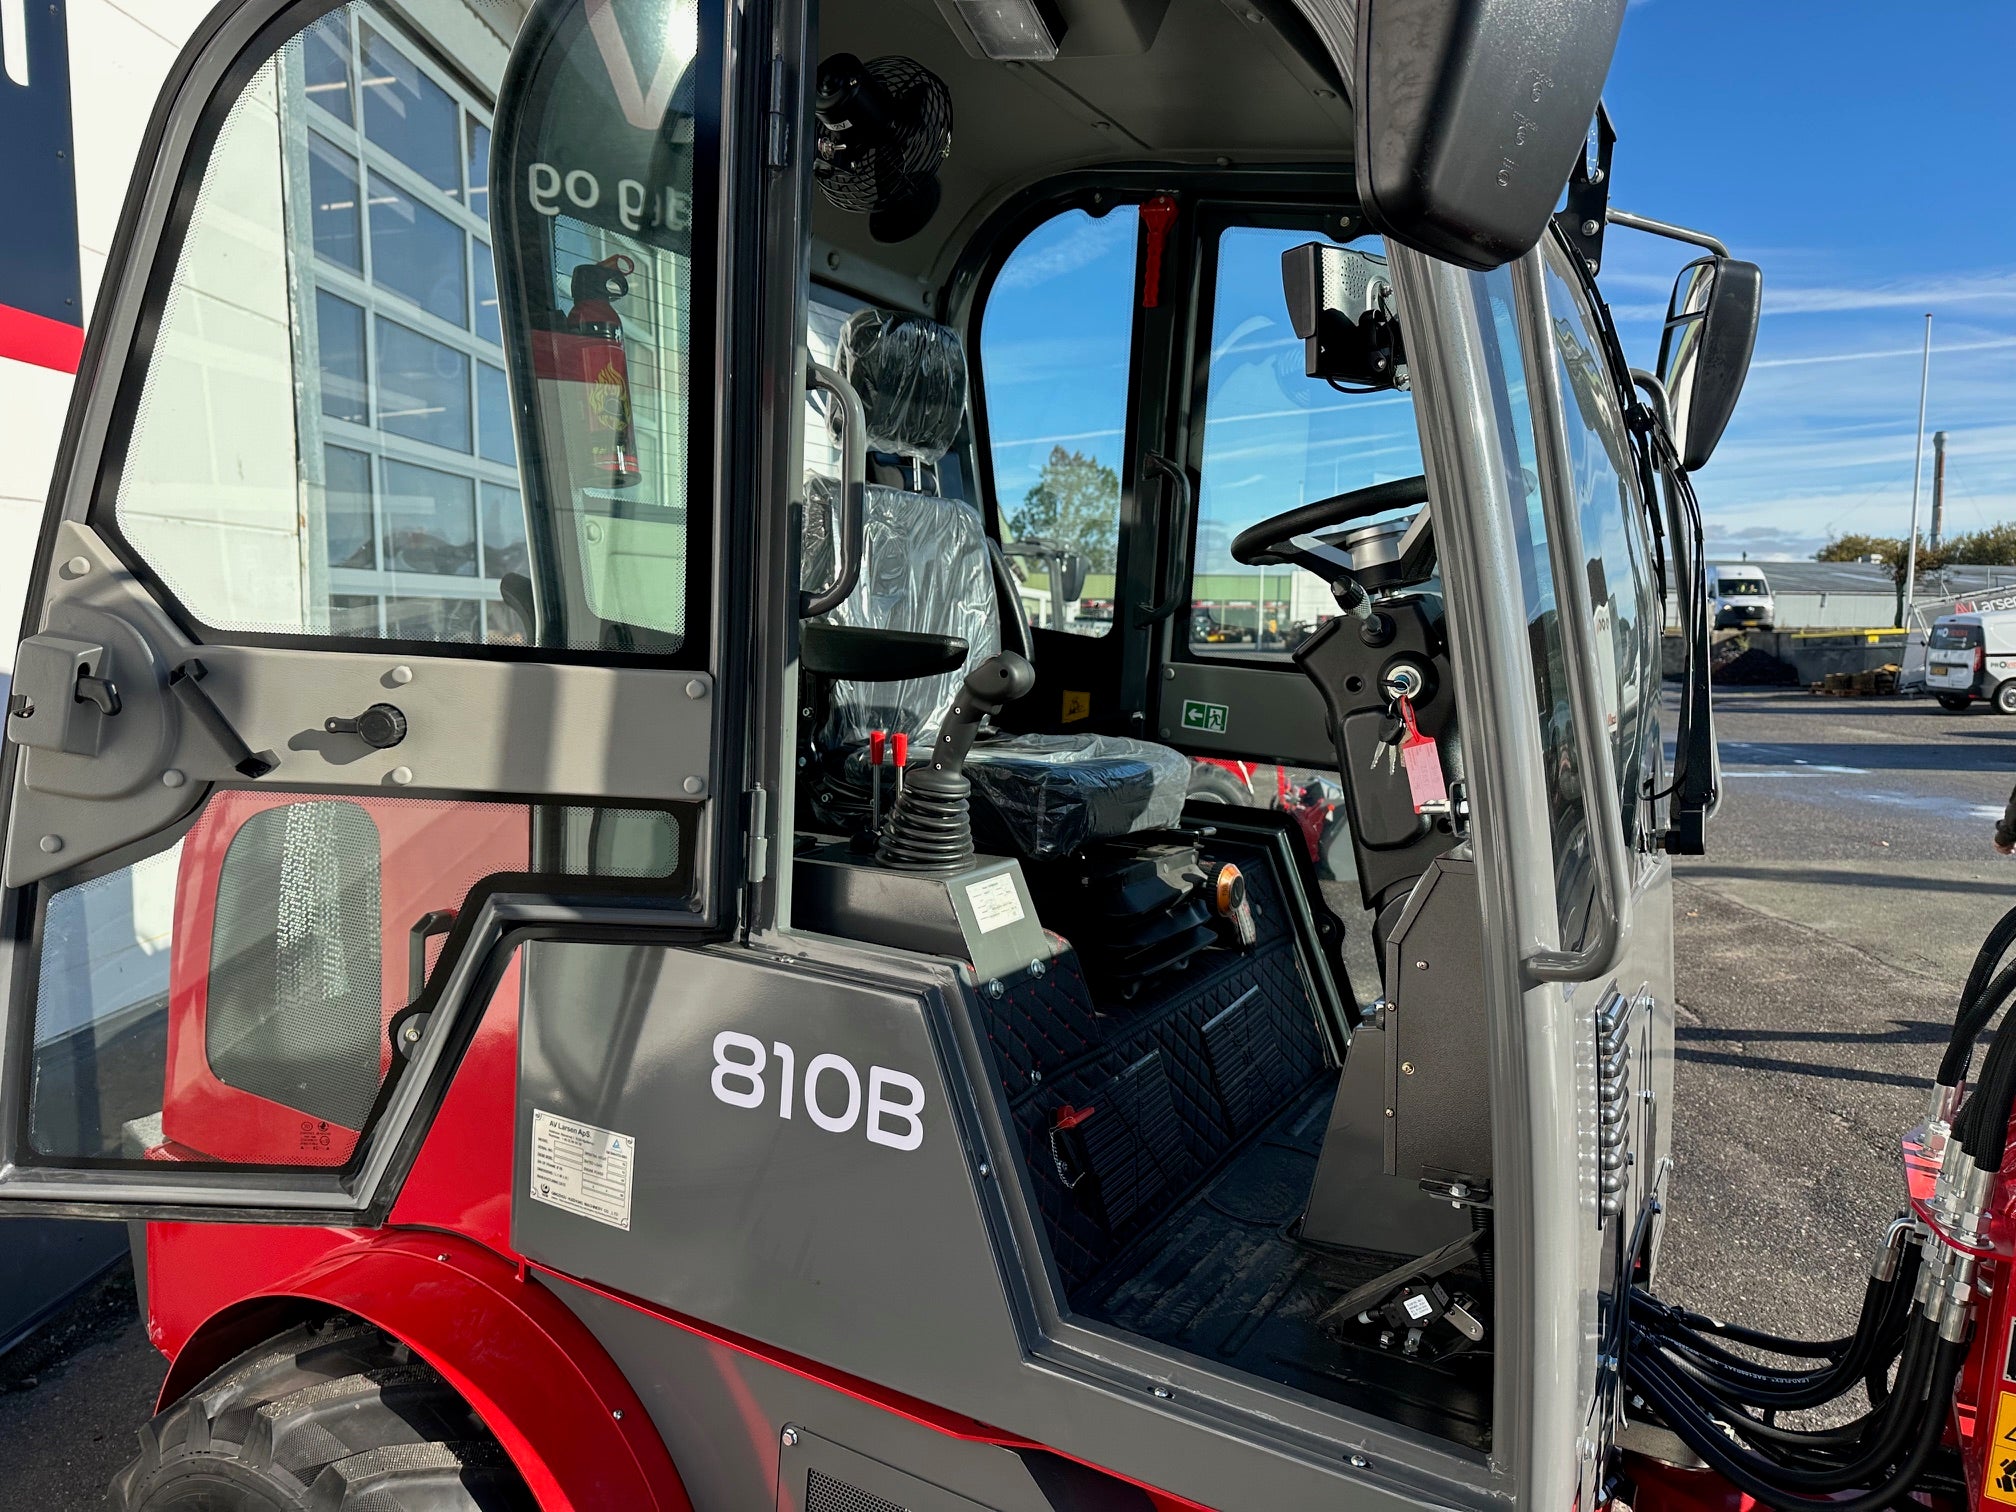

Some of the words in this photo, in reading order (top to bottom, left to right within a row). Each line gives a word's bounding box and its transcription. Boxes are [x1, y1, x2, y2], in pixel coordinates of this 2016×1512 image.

[711, 1030, 926, 1151] 810B
[549, 1120, 557, 1128] AV
[558, 1122, 577, 1134] Larsen
